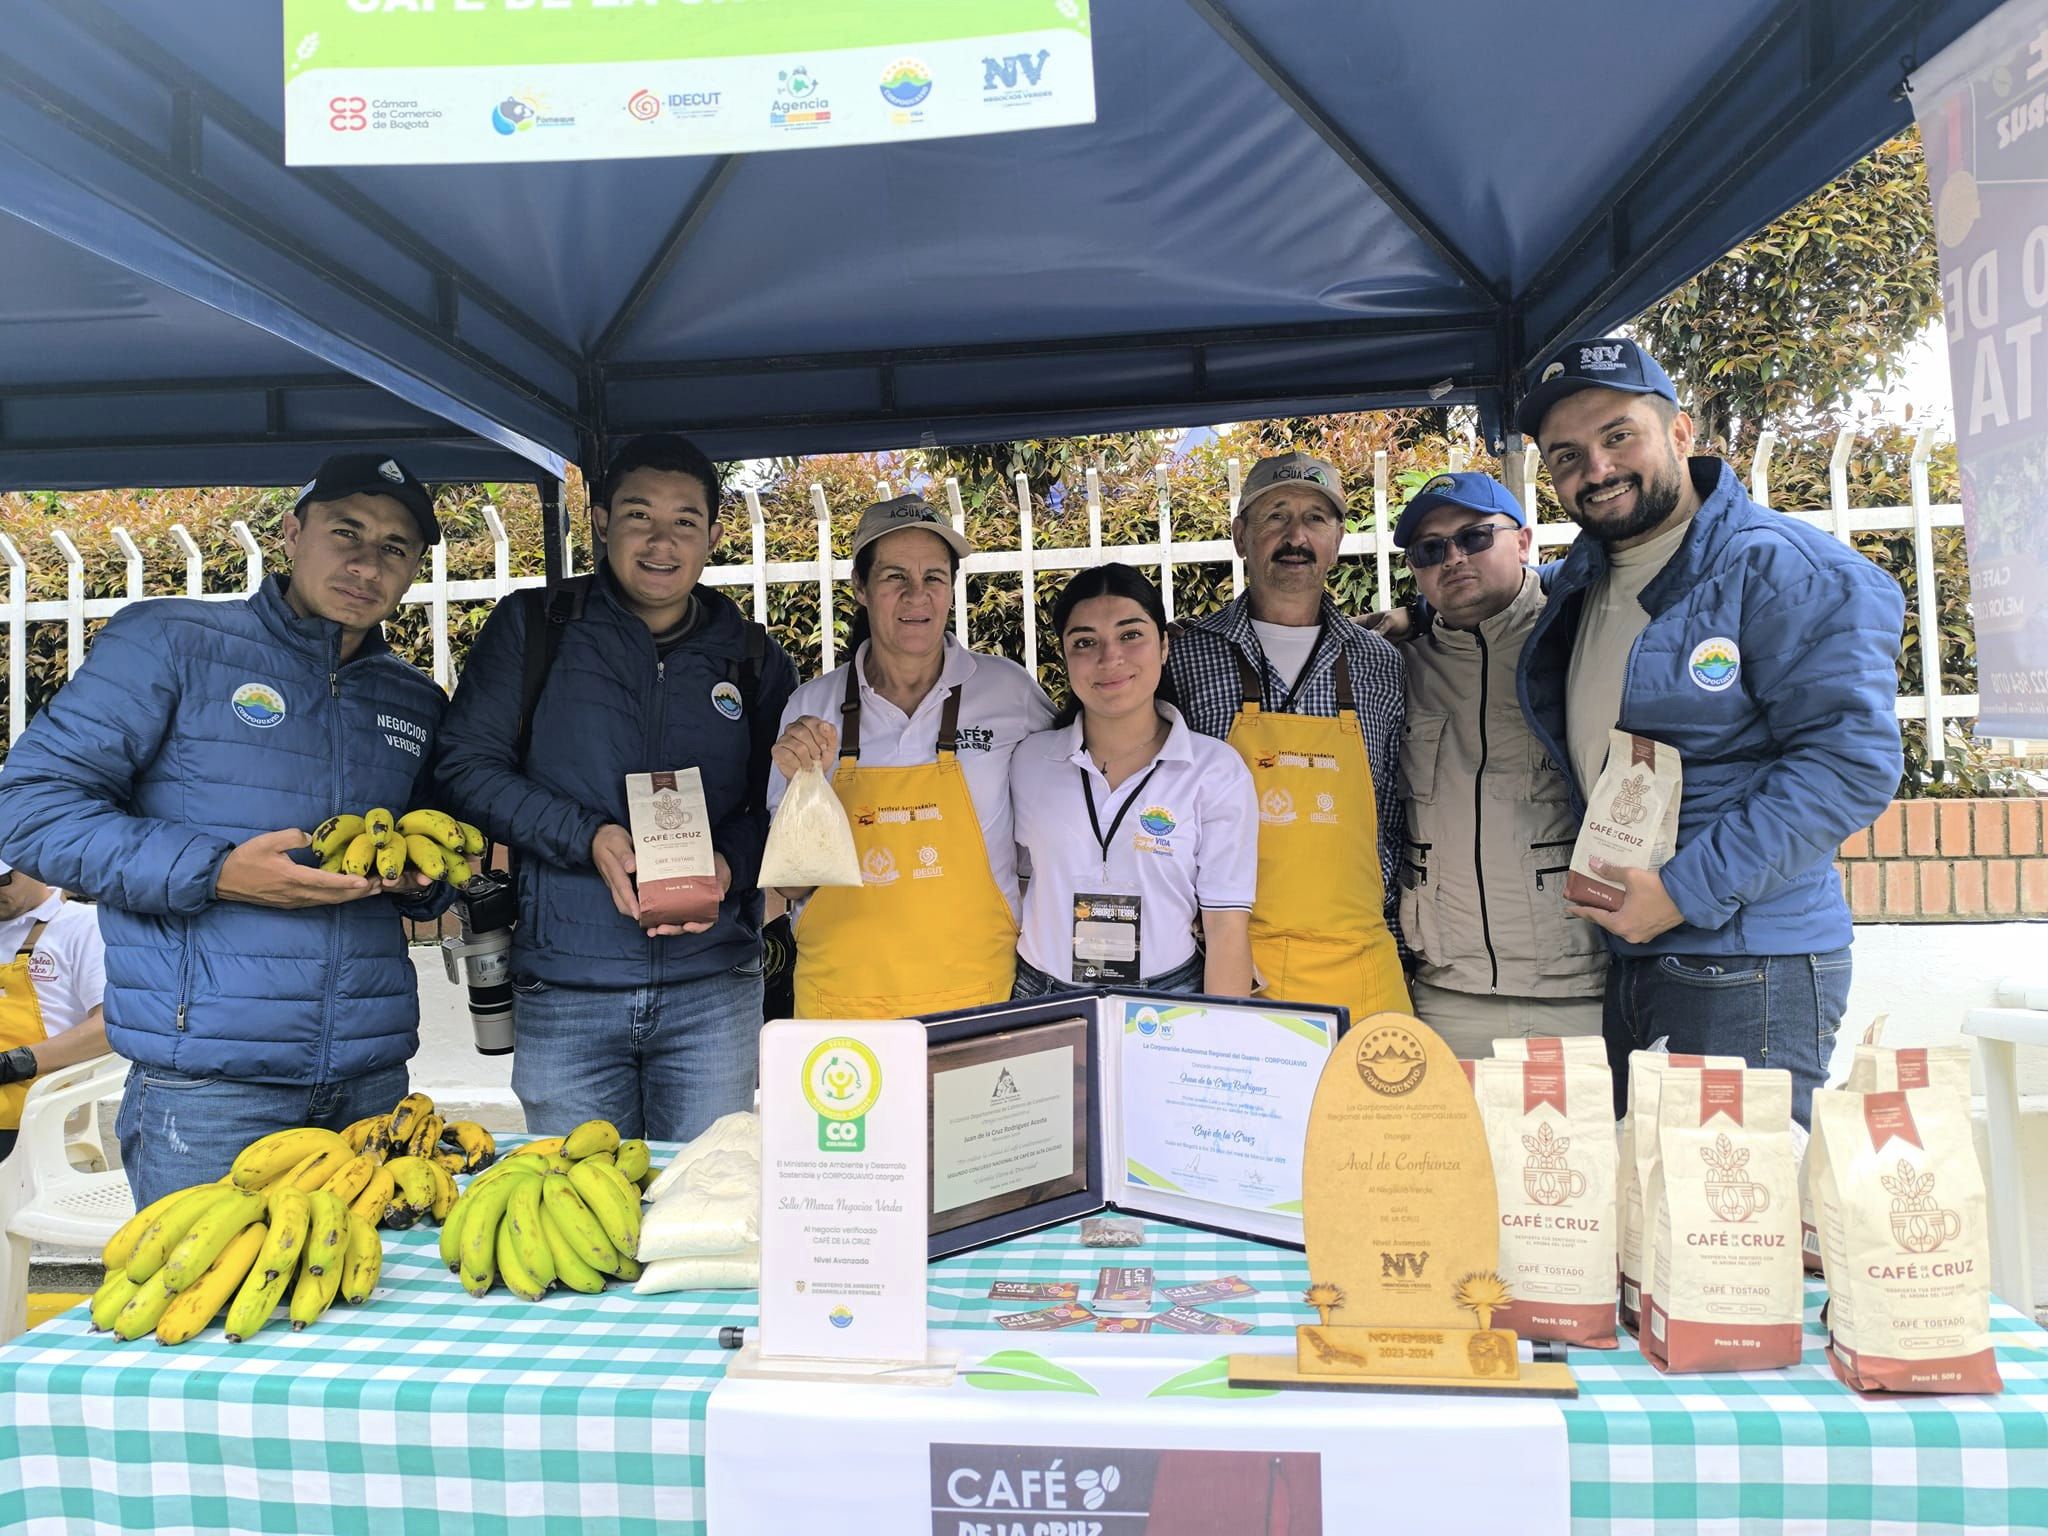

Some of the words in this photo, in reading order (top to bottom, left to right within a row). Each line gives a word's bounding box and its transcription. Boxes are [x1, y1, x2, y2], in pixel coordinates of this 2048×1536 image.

[372, 99, 418, 109] Cámara
[668, 92, 721, 107] IDECUT
[771, 98, 829, 114] Agencia
[372, 110, 387, 119] de
[389, 109, 442, 119] Comercio
[373, 120, 387, 129] de
[390, 119, 429, 131] Bogotá
[237, 705, 280, 724] CORPOGUAVIO
[377, 713, 427, 743] NEGOCIOS
[955, 726, 982, 742] AFÉ
[384, 733, 421, 757] VERDES
[643, 832, 668, 843] CAFÉ
[675, 831, 702, 839] CRUZ
[1589, 821, 1613, 836] CAFÉ
[1618, 832, 1644, 847] CRUZ
[1363, 1069, 1421, 1094] CORPOGUAVIO
[826, 1122, 858, 1141] CO
[1232, 1130, 1255, 1146] Cruz
[964, 1135, 977, 1143] Juan
[784, 1160, 816, 1168] Ministerio
[829, 1161, 864, 1169] Ambiente
[871, 1162, 907, 1170] Desarrollo
[1338, 1151, 1373, 1171] Aval
[1377, 1152, 1390, 1171] de
[1395, 1151, 1462, 1175] Confianza
[779, 1171, 815, 1179] Sostenible
[822, 1172, 874, 1180] CORPOGUAVIO
[875, 1174, 904, 1182] otorgan
[836, 1198, 872, 1214] Negocios
[875, 1199, 903, 1212] Verdes
[1501, 1213, 1542, 1228] CAFÉ
[1555, 1217, 1600, 1232] CRUZ
[812, 1226, 841, 1235] negocio
[842, 1226, 878, 1234] verificado
[1687, 1231, 1728, 1246] CAFÉ
[1741, 1234, 1785, 1247] CRUZ
[814, 1256, 831, 1264] Nivel
[1518, 1264, 1540, 1273] CAFÉ
[1544, 1266, 1585, 1276] TOSTADO
[1868, 1263, 1918, 1279] CAFÉ
[1932, 1259, 1974, 1277] CRUZ
[1703, 1285, 1725, 1295] CAFÉ
[1730, 1287, 1770, 1296] TOSTADO
[1531, 1316, 1549, 1324] Peso
[1559, 1318, 1572, 1326] 500
[1892, 1319, 1919, 1328] CAFÉ
[1924, 1316, 1965, 1328] TOSTADO
[1368, 1332, 1445, 1345] NOVIEMBRE
[1714, 1338, 1732, 1347] Peso
[1742, 1339, 1755, 1347] 500
[1379, 1347, 1434, 1360] 2023-2024
[1912, 1374, 1930, 1382] Peso
[1941, 1372, 1955, 1380] 500
[946, 1458, 1067, 1509] CAFÉ
